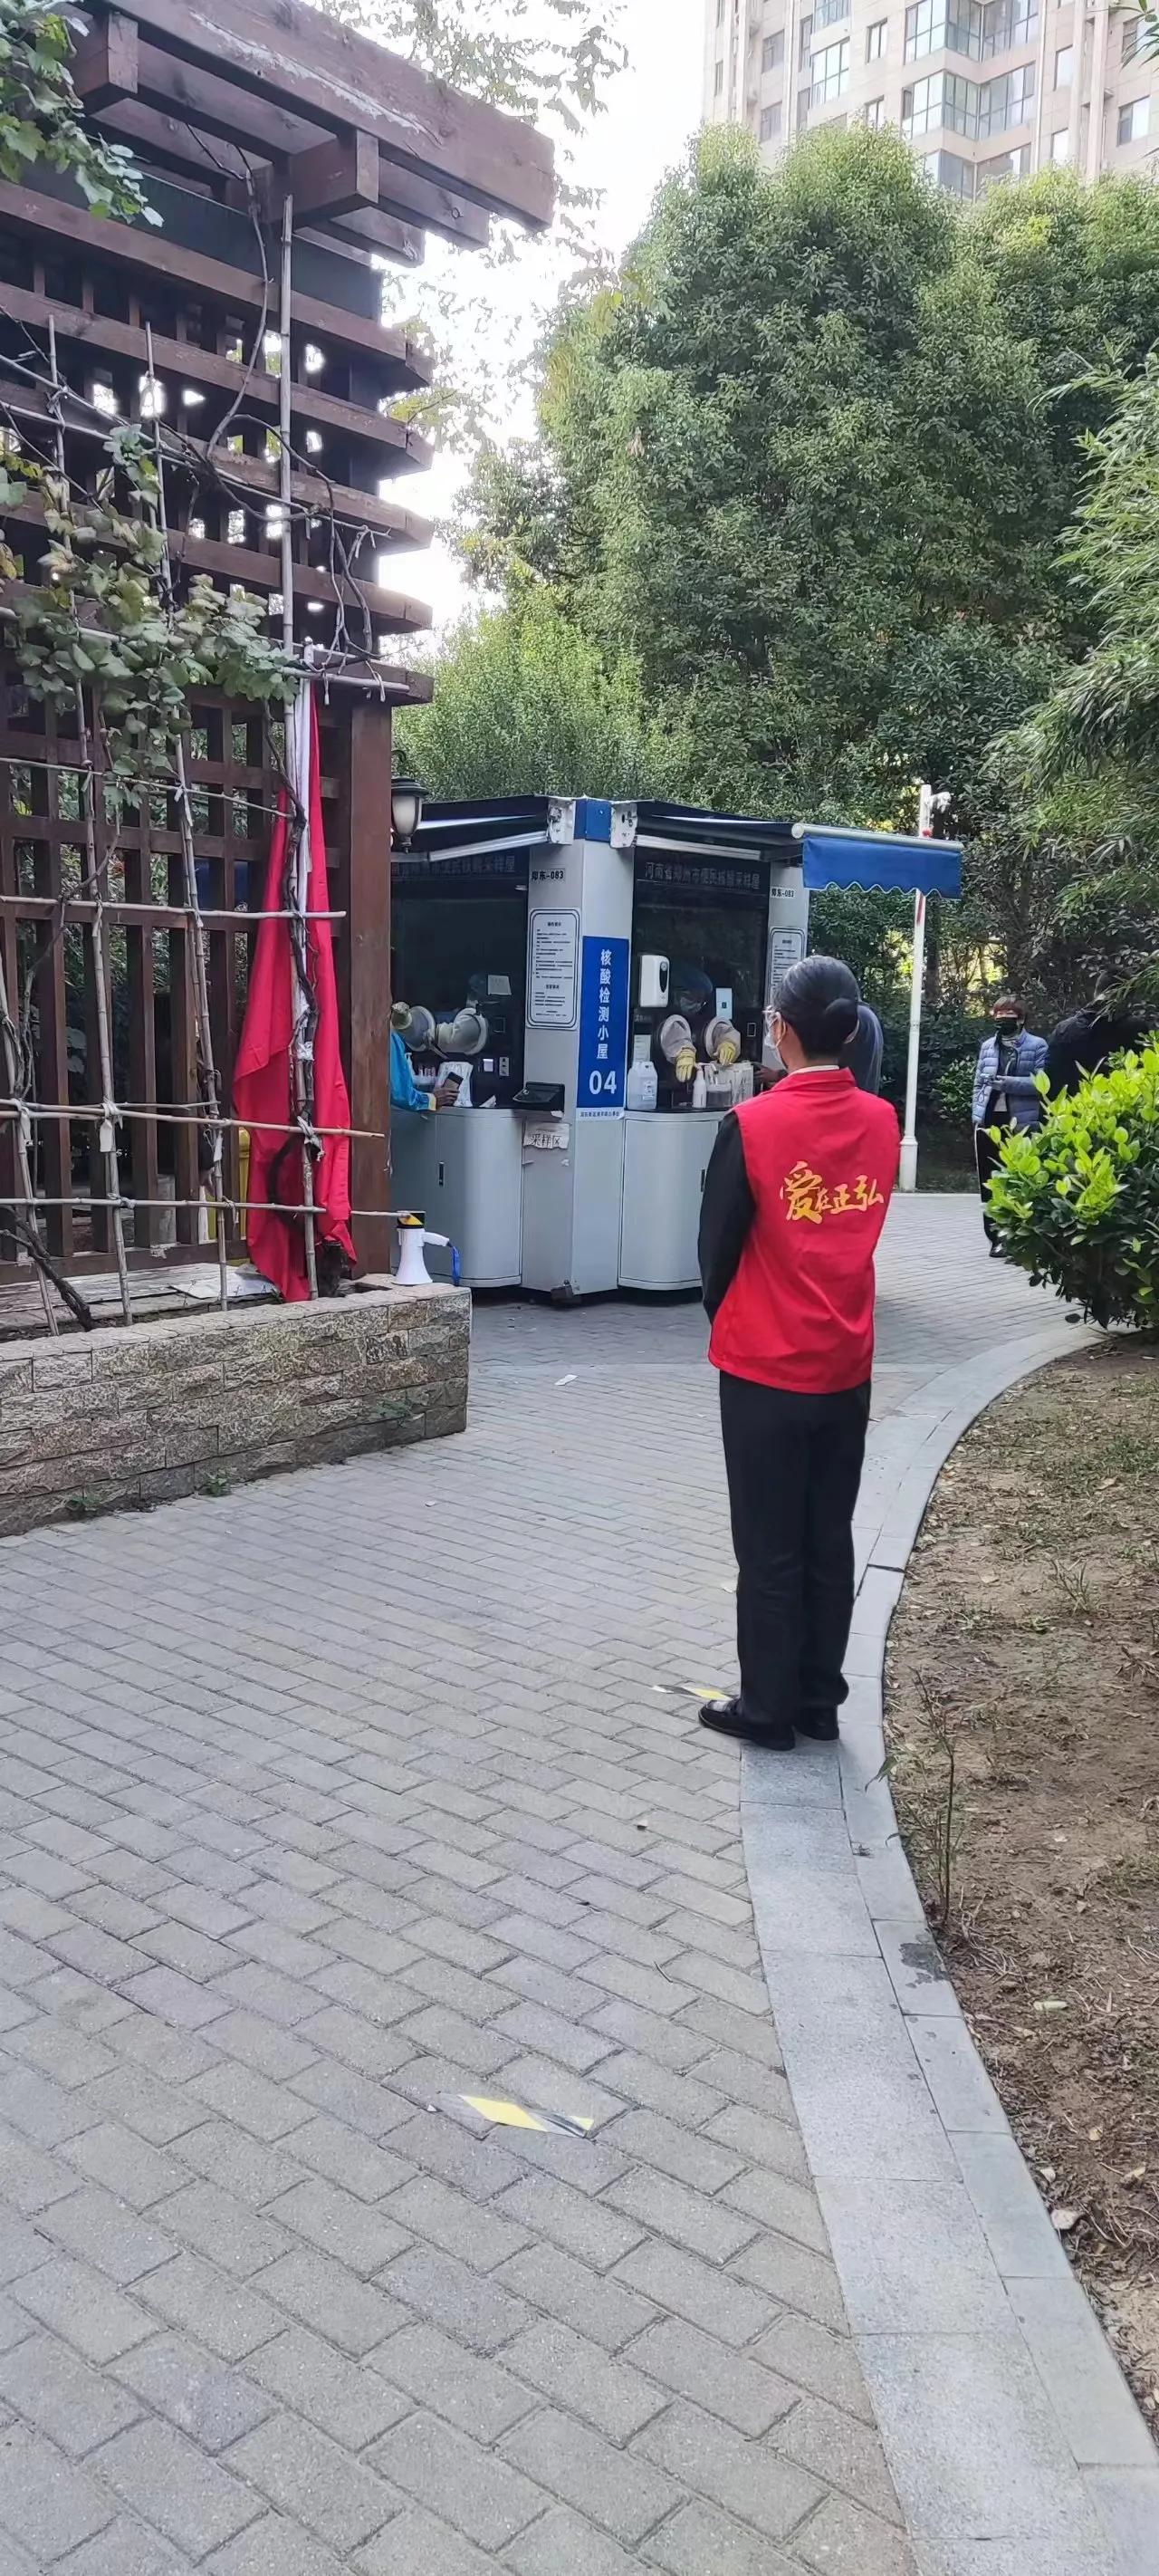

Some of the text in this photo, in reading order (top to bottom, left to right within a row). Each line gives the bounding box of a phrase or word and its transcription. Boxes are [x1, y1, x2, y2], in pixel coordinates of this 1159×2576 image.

[596, 948, 612, 1060] 核酸检测小屋
[589, 1070, 618, 1095] 04
[529, 1132, 562, 1147] 采样区
[779, 1160, 885, 1225] 爱在正弘
